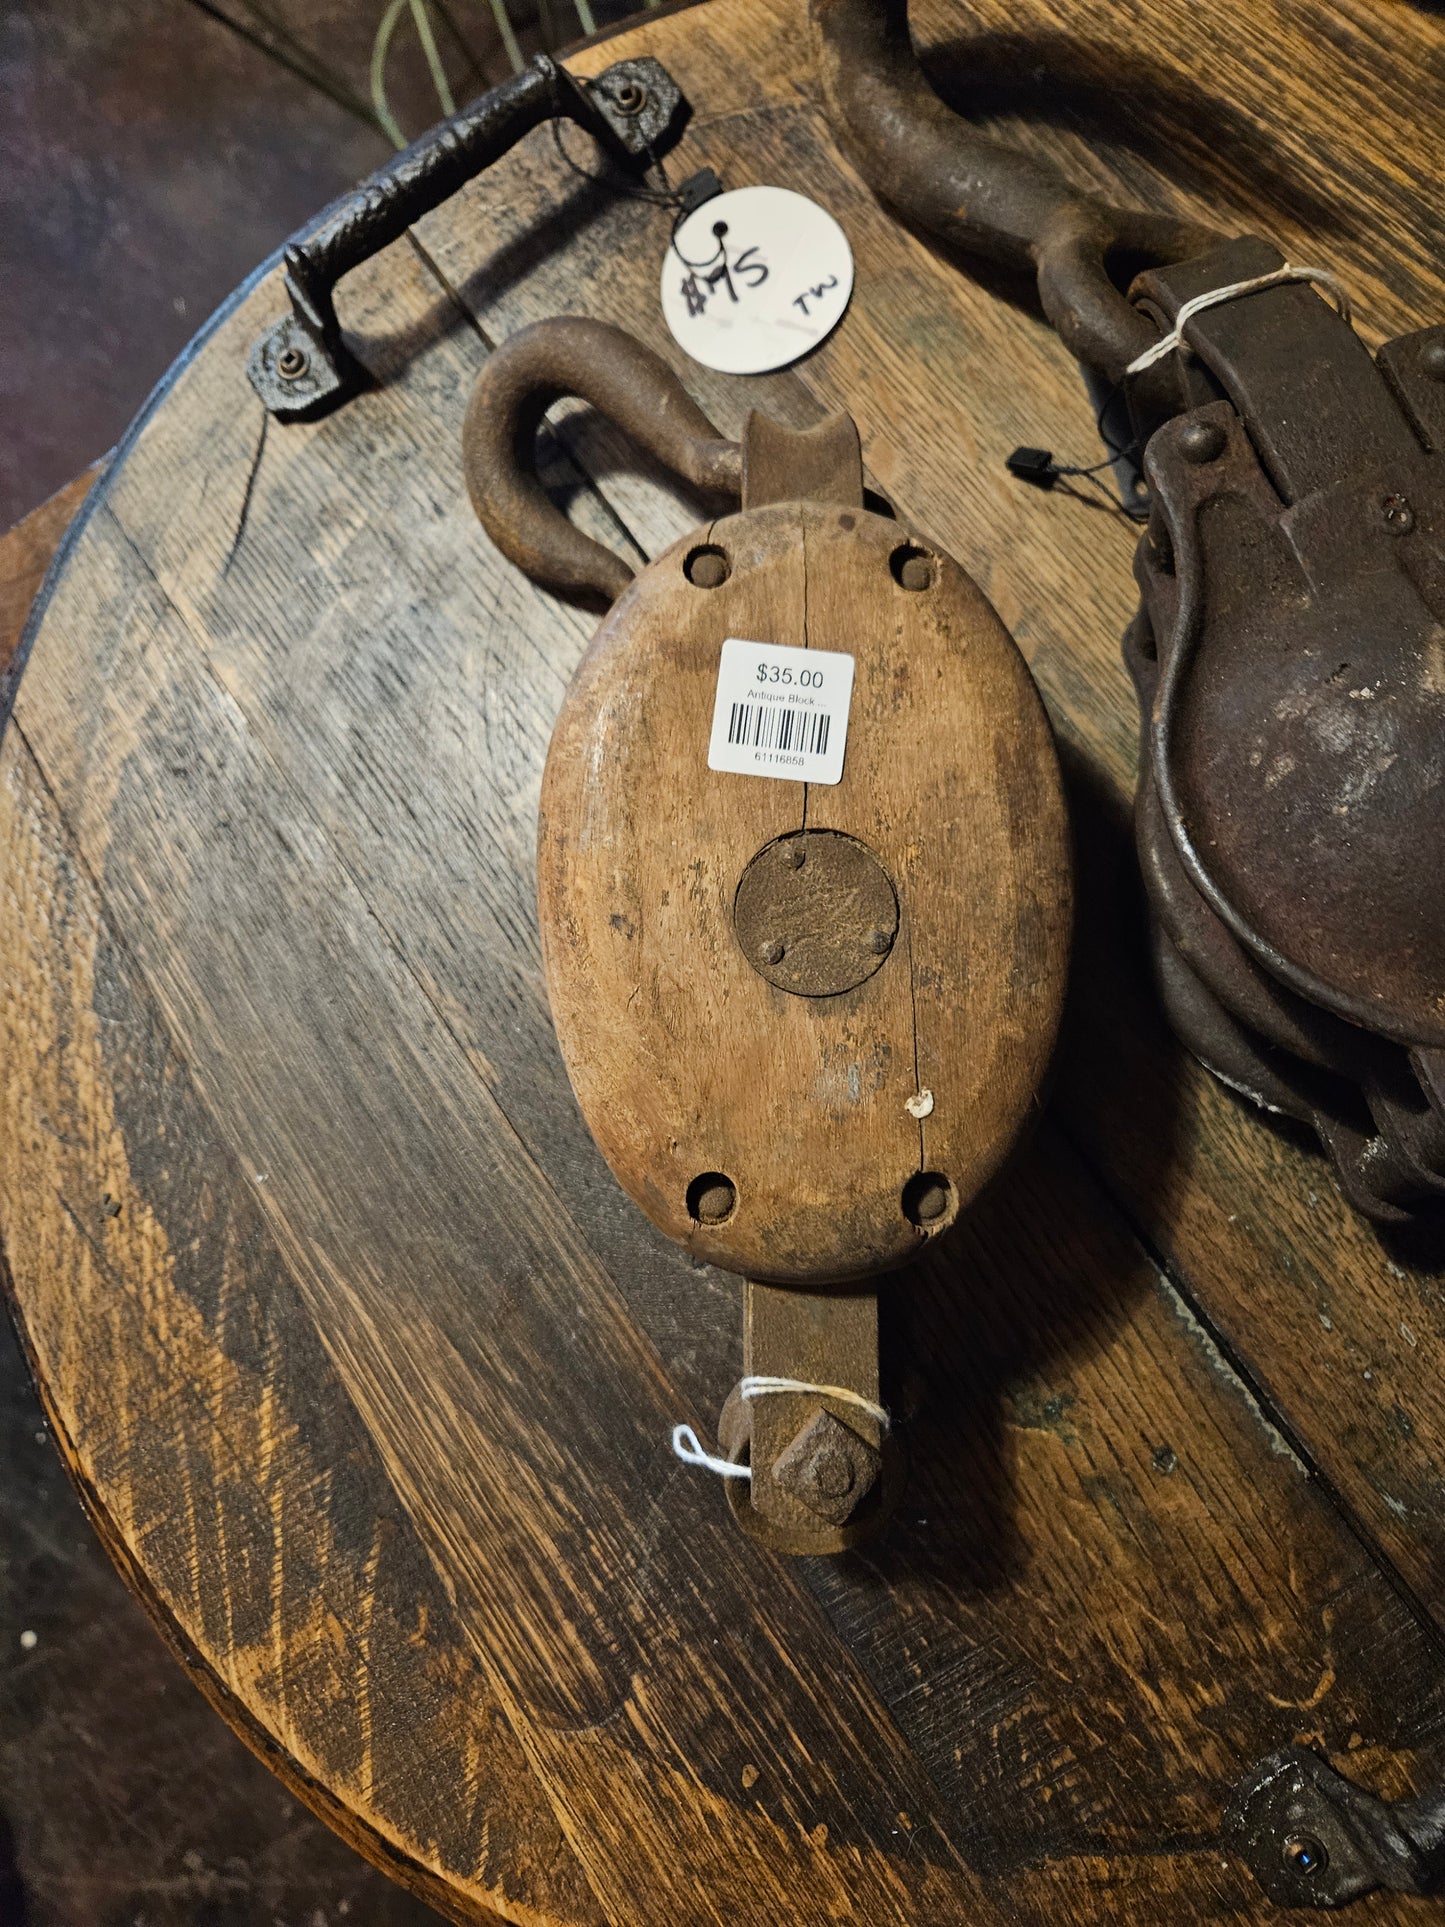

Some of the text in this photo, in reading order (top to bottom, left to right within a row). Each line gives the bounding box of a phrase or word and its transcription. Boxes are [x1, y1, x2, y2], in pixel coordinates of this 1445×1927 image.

[756, 662, 824, 689] $35.00
[747, 689, 785, 702] Antique
[788, 694, 815, 705] Block
[754, 752, 805, 766] 61116858
